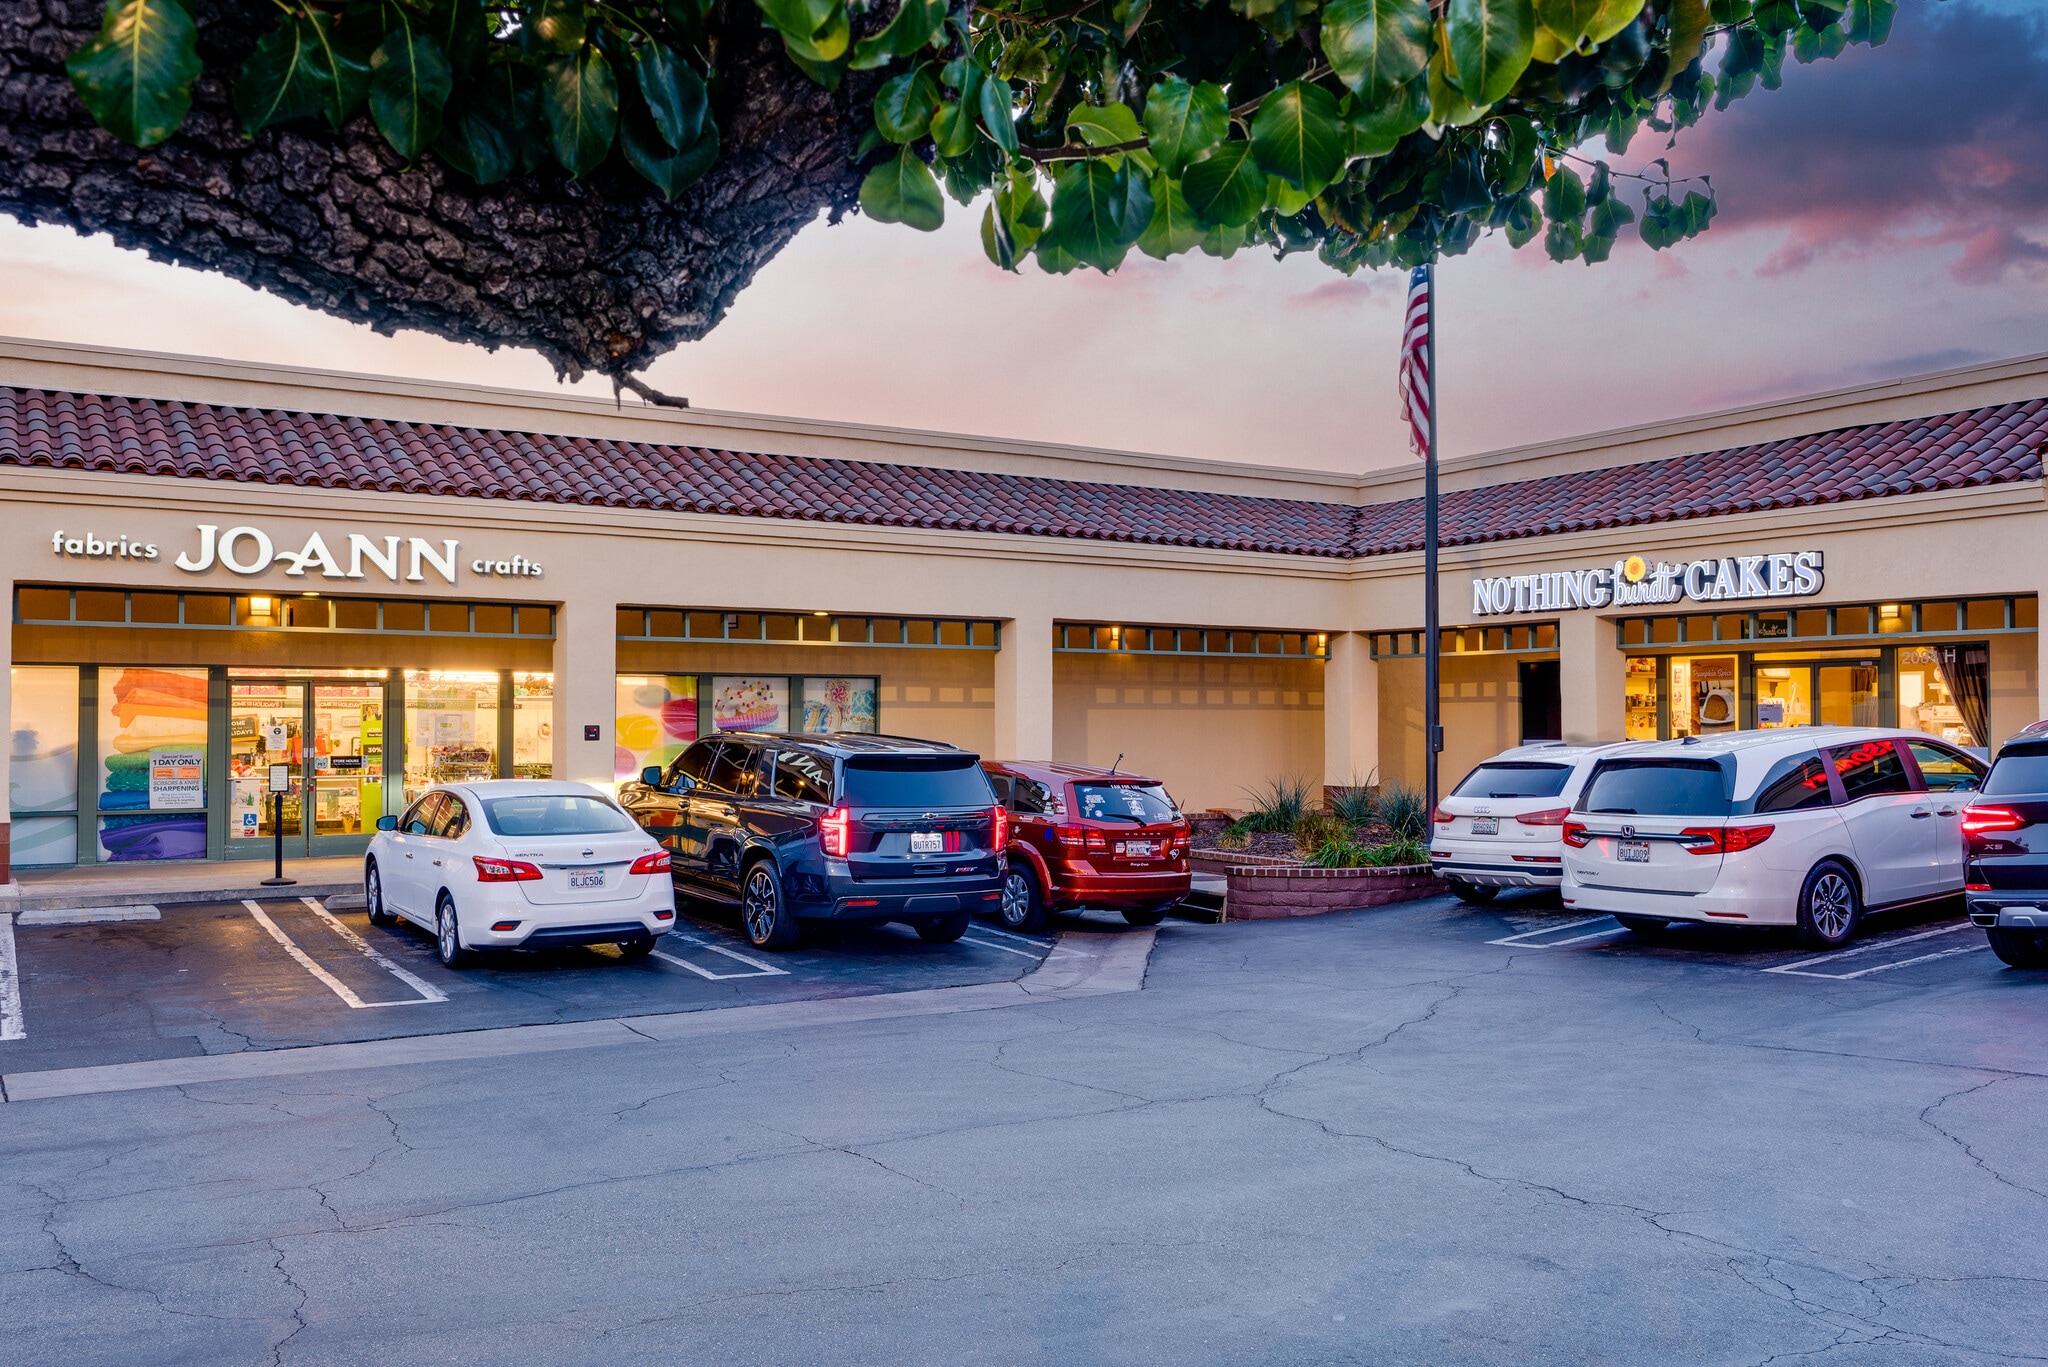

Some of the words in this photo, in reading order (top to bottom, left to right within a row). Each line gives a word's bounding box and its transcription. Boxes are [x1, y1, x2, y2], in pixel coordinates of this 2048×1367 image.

[52, 530, 159, 559] fabrics
[471, 554, 543, 577] crafts
[1472, 568, 1612, 615] NOTHING
[1610, 556, 1684, 606] bundt
[1684, 550, 1824, 601] CAKES
[1901, 650, 1939, 665] 2084
[1944, 648, 1956, 663] H
[913, 840, 941, 850] 8UTR757
[570, 876, 604, 888] 8LJC506
